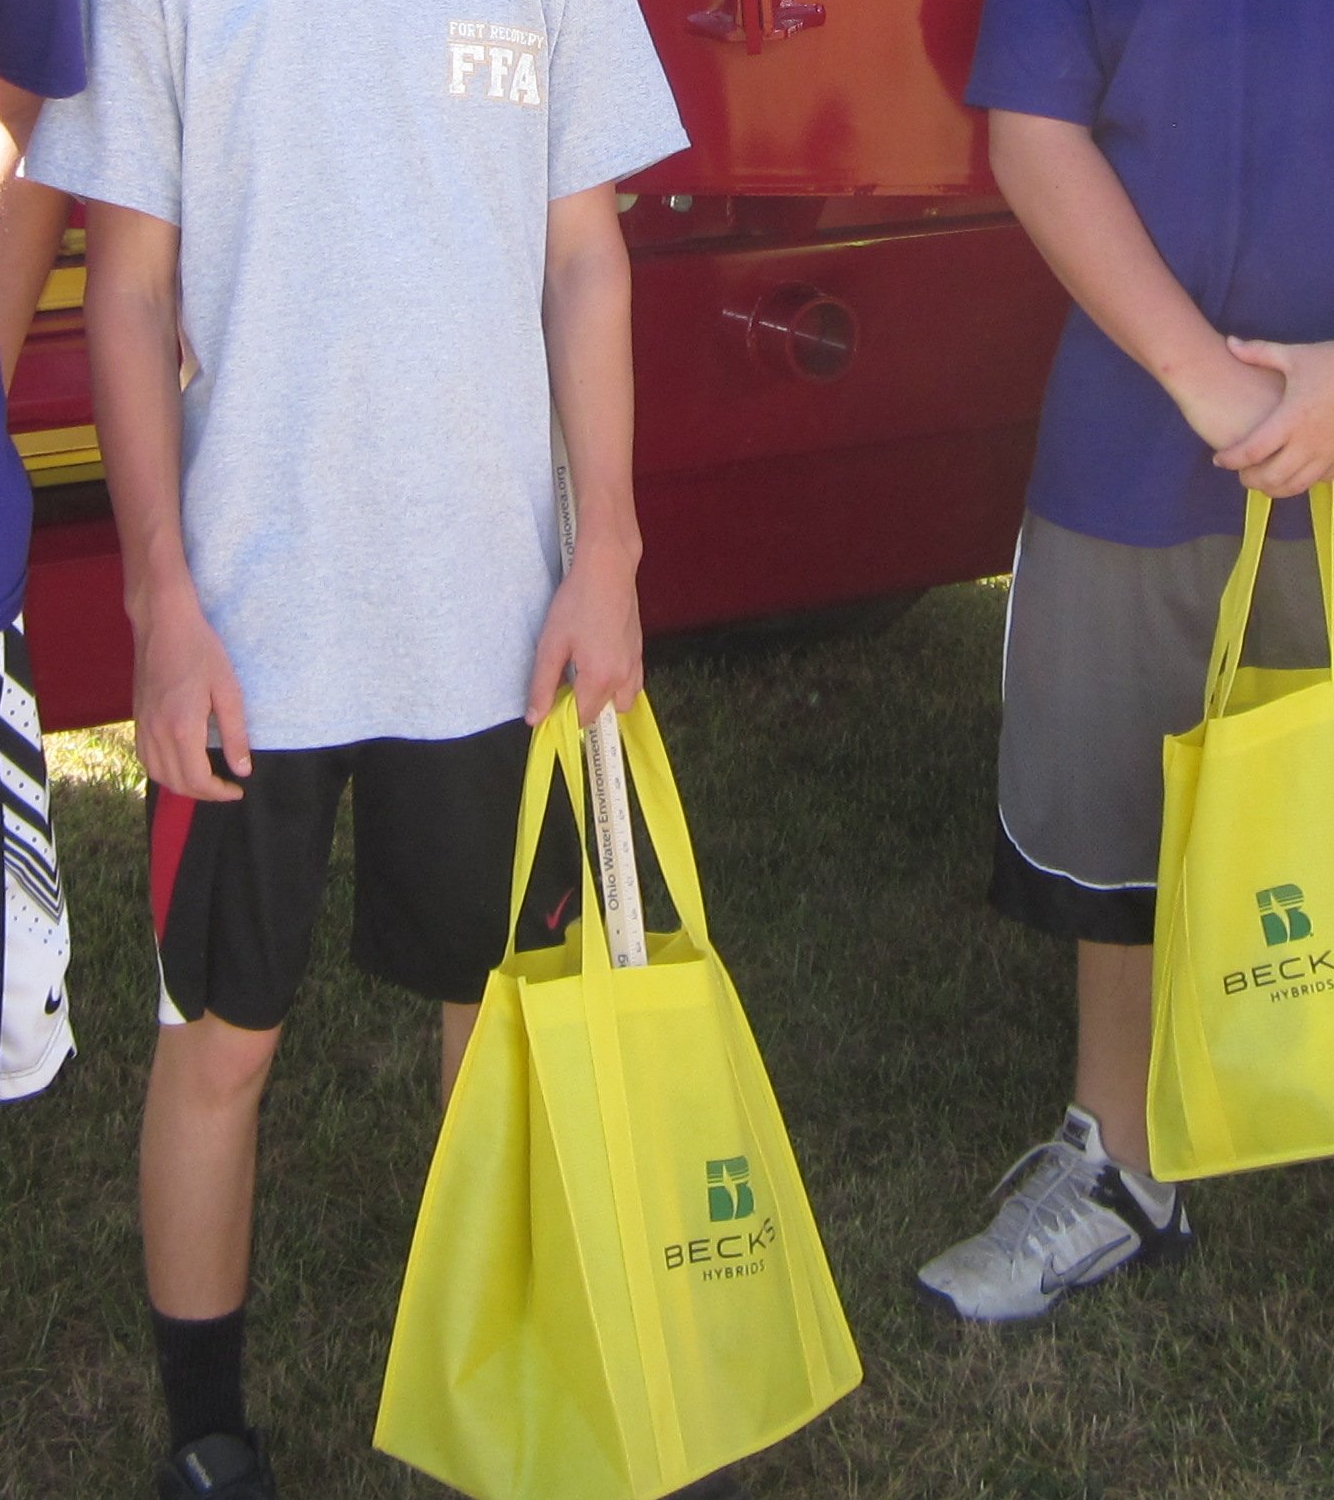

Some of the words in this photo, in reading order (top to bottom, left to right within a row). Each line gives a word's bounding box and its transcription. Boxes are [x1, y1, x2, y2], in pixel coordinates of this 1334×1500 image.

[448, 20, 486, 38] FORT
[447, 42, 542, 106] FFA
[589, 727, 610, 825] Environment
[601, 827, 615, 873] Water
[607, 875, 619, 911] Ohio
[1270, 978, 1334, 1003] HYBRIDS
[664, 1217, 775, 1270] BECKS
[703, 1258, 766, 1282] HYBRIDS
